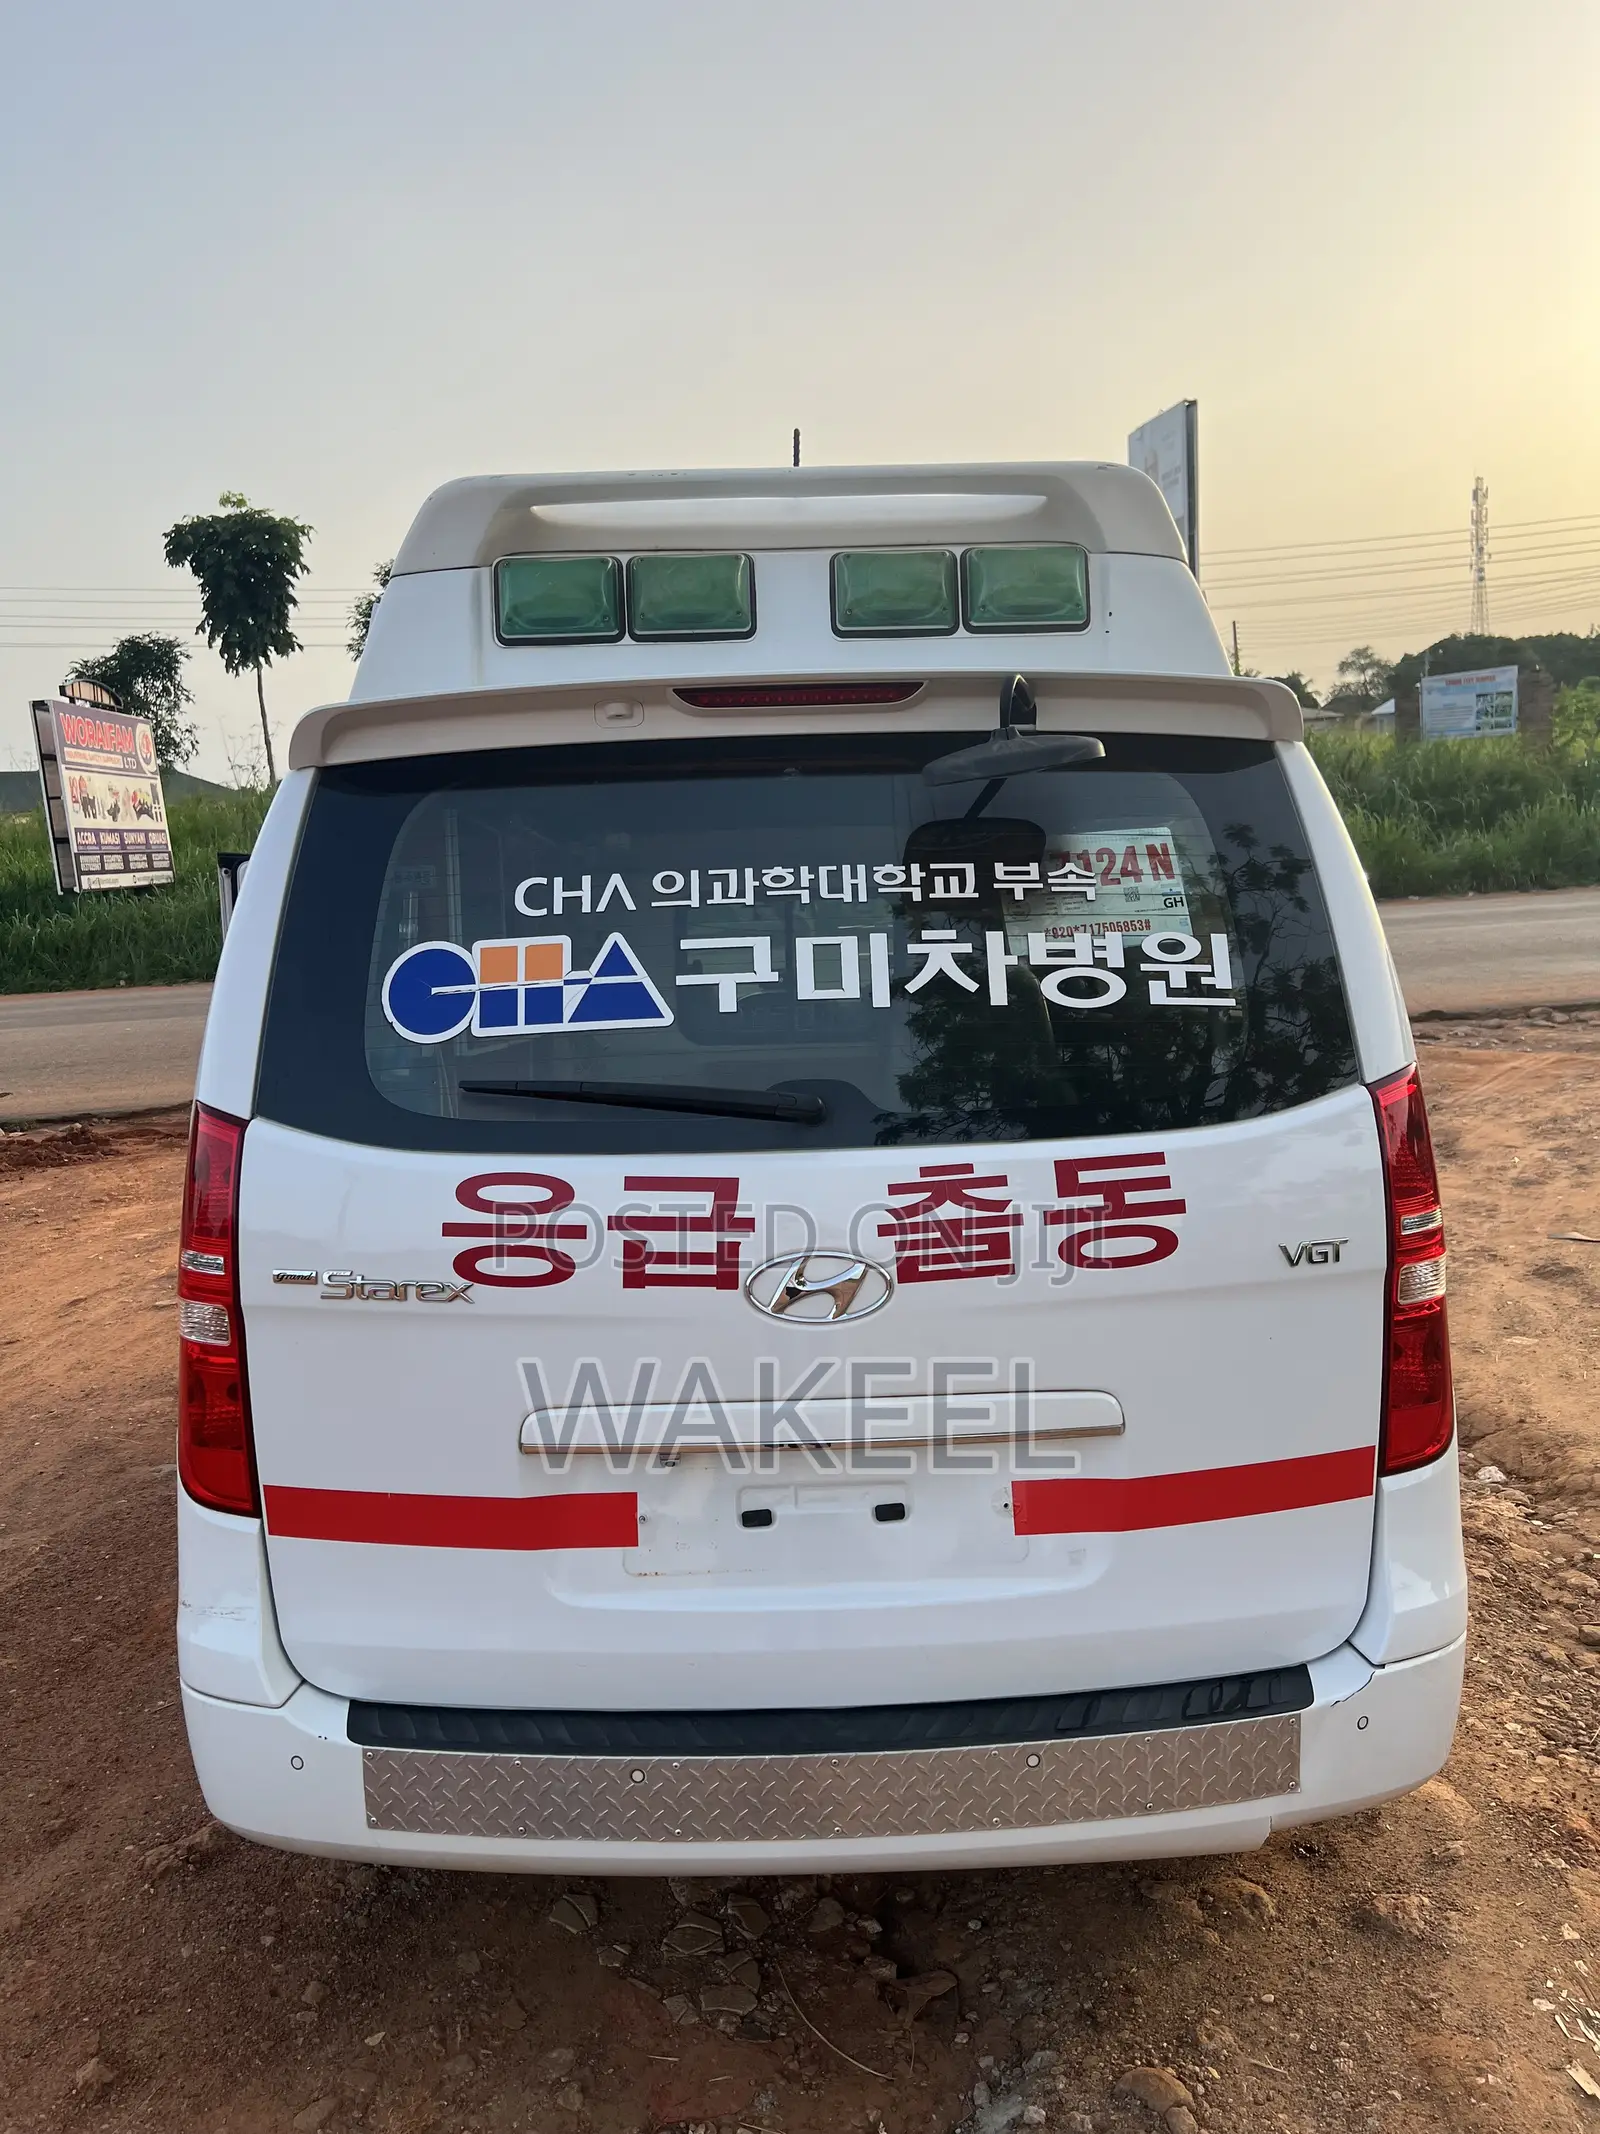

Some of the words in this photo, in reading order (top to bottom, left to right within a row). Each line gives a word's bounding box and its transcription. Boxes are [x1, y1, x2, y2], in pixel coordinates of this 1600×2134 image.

[123, 757, 137, 770] LTD
[77, 832, 97, 845] ACCRA
[100, 832, 121, 845] KUMASI
[123, 832, 146, 845] SUNYANI
[1145, 842, 1175, 881] N
[514, 872, 637, 916] CHA
[651, 862, 980, 908] 의과학대학교
[993, 862, 1097, 901] 부속
[1163, 896, 1185, 909] GH
[675, 930, 1237, 1009] 구미차병원
[441, 1171, 756, 1291] 응급
[876, 1151, 1187, 1285] 출동
[1278, 1236, 1350, 1268] VGT
[275, 1270, 315, 1283] Grand
[320, 1269, 476, 1304] Starex
